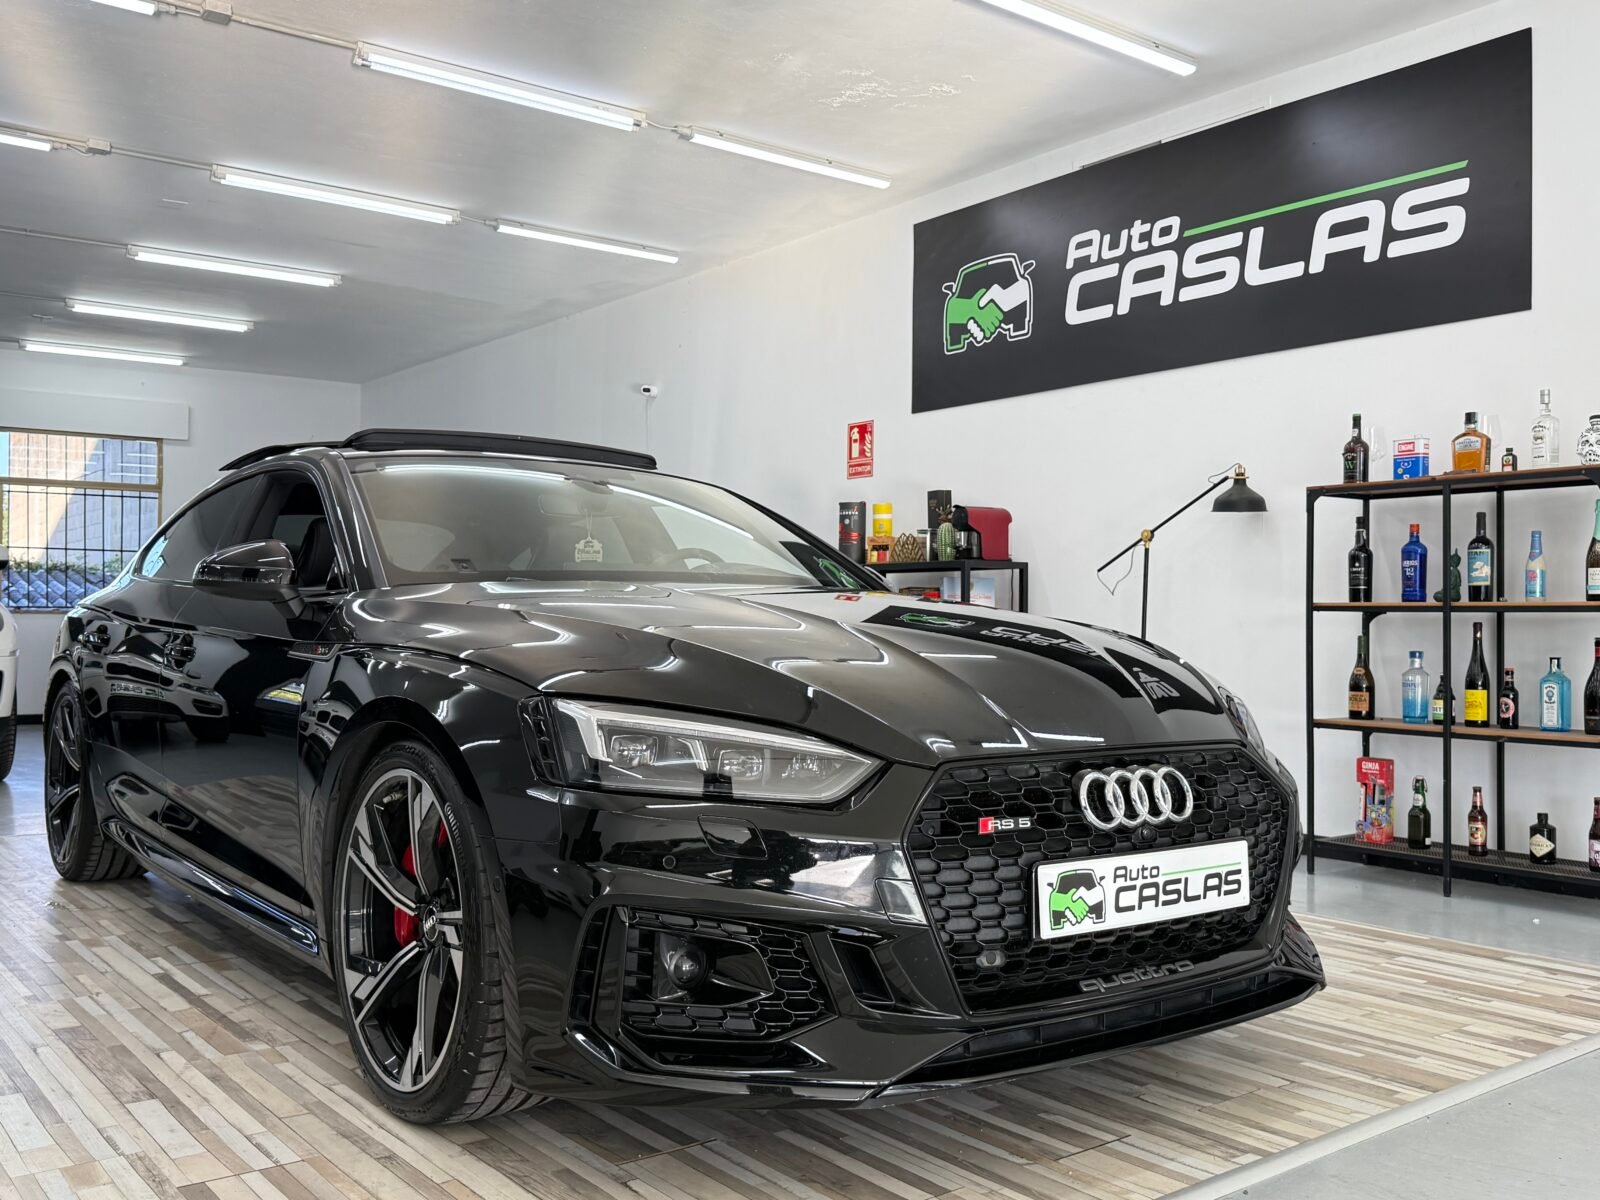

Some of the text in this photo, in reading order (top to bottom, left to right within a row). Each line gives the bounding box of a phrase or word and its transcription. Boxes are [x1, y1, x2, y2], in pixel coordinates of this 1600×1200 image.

[1065, 216, 1181, 271] Auto
[1065, 177, 1470, 325] CASLAS
[849, 465, 871, 474] EXTINTOR
[1112, 864, 1160, 884] Auto
[1114, 868, 1242, 914] CASLAS
[1079, 959, 1195, 993] quattro
